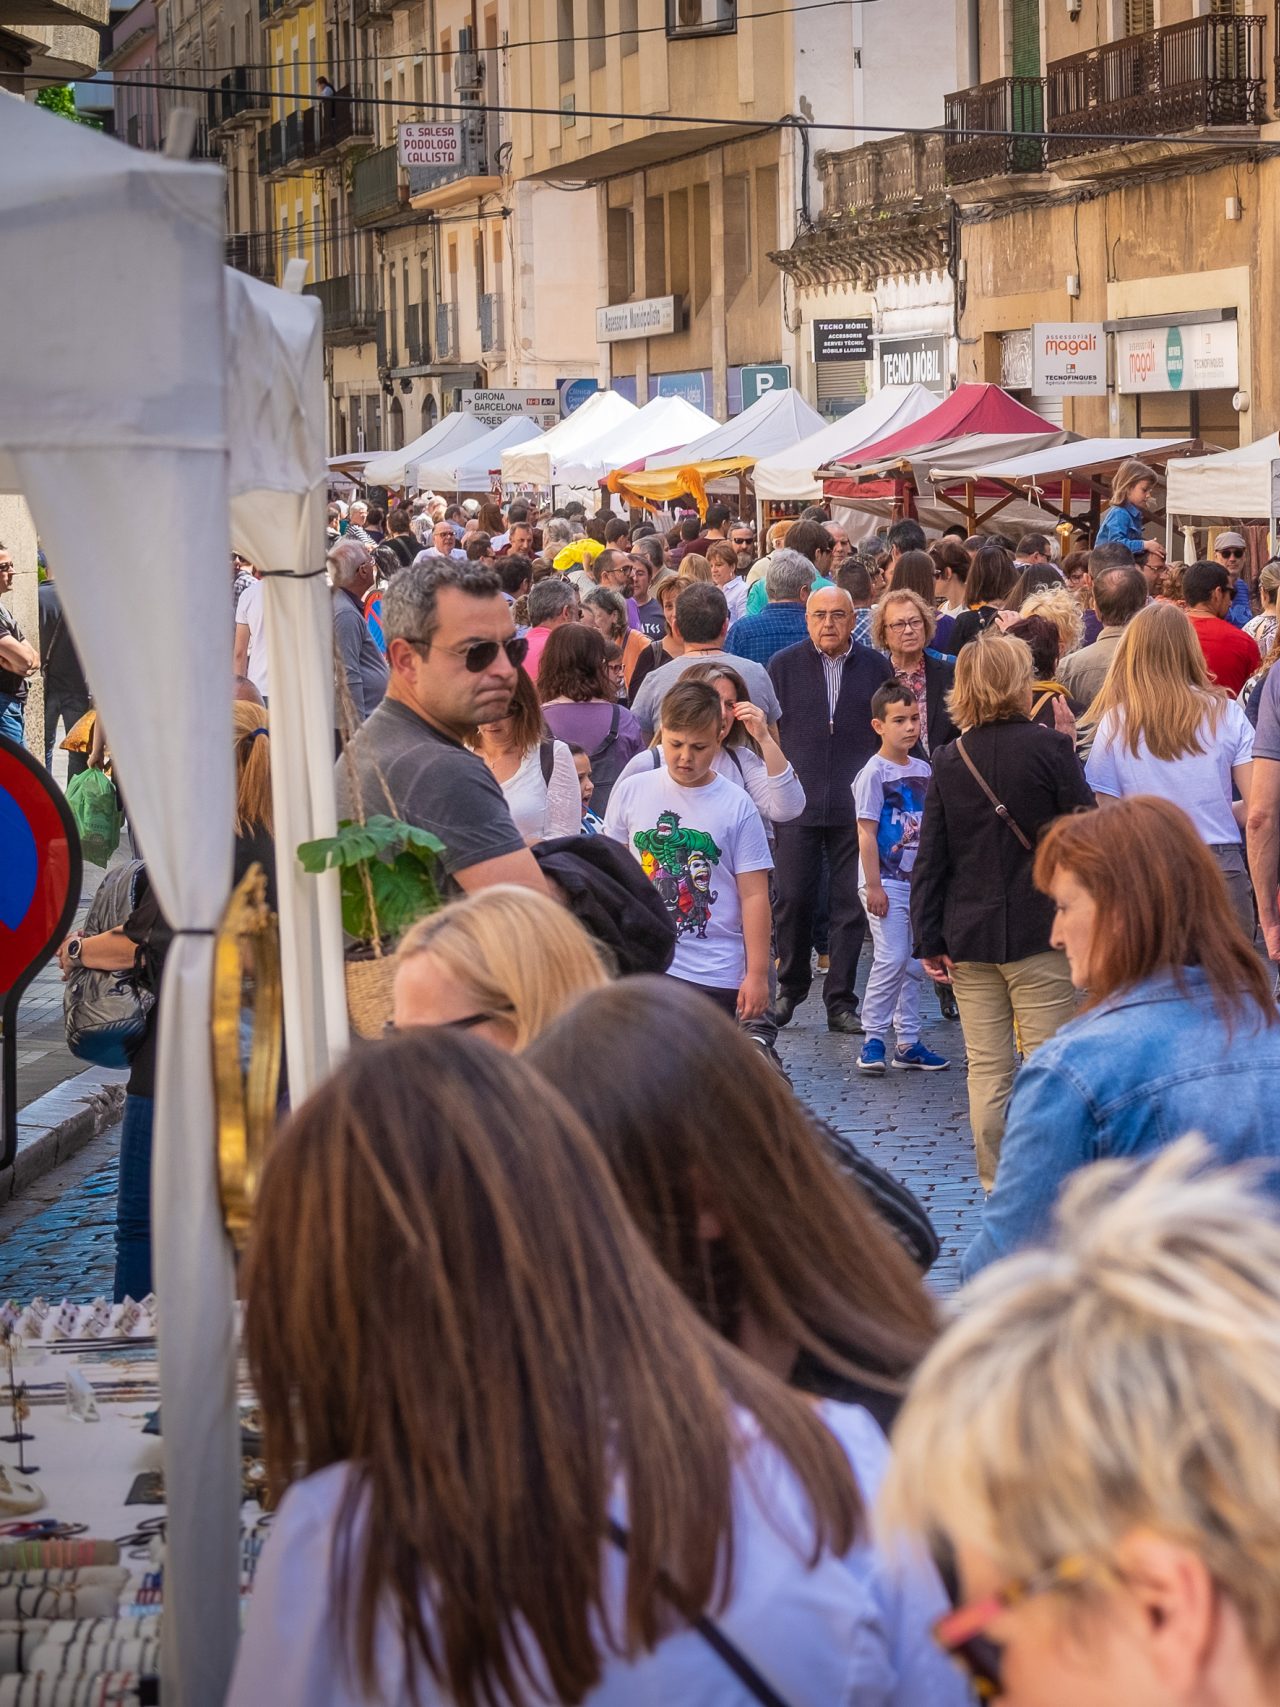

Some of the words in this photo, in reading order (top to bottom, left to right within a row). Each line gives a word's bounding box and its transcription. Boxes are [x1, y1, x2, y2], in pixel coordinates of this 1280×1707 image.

[405, 127, 414, 137] G.
[418, 127, 454, 137] SALESA
[404, 139, 457, 150] PODOLOGO
[407, 152, 455, 163] CALLISTA
[883, 352, 911, 384] TECNO
[756, 373, 774, 397] P
[474, 392, 505, 401] GIRONA
[474, 402, 523, 411] BARCELONA
